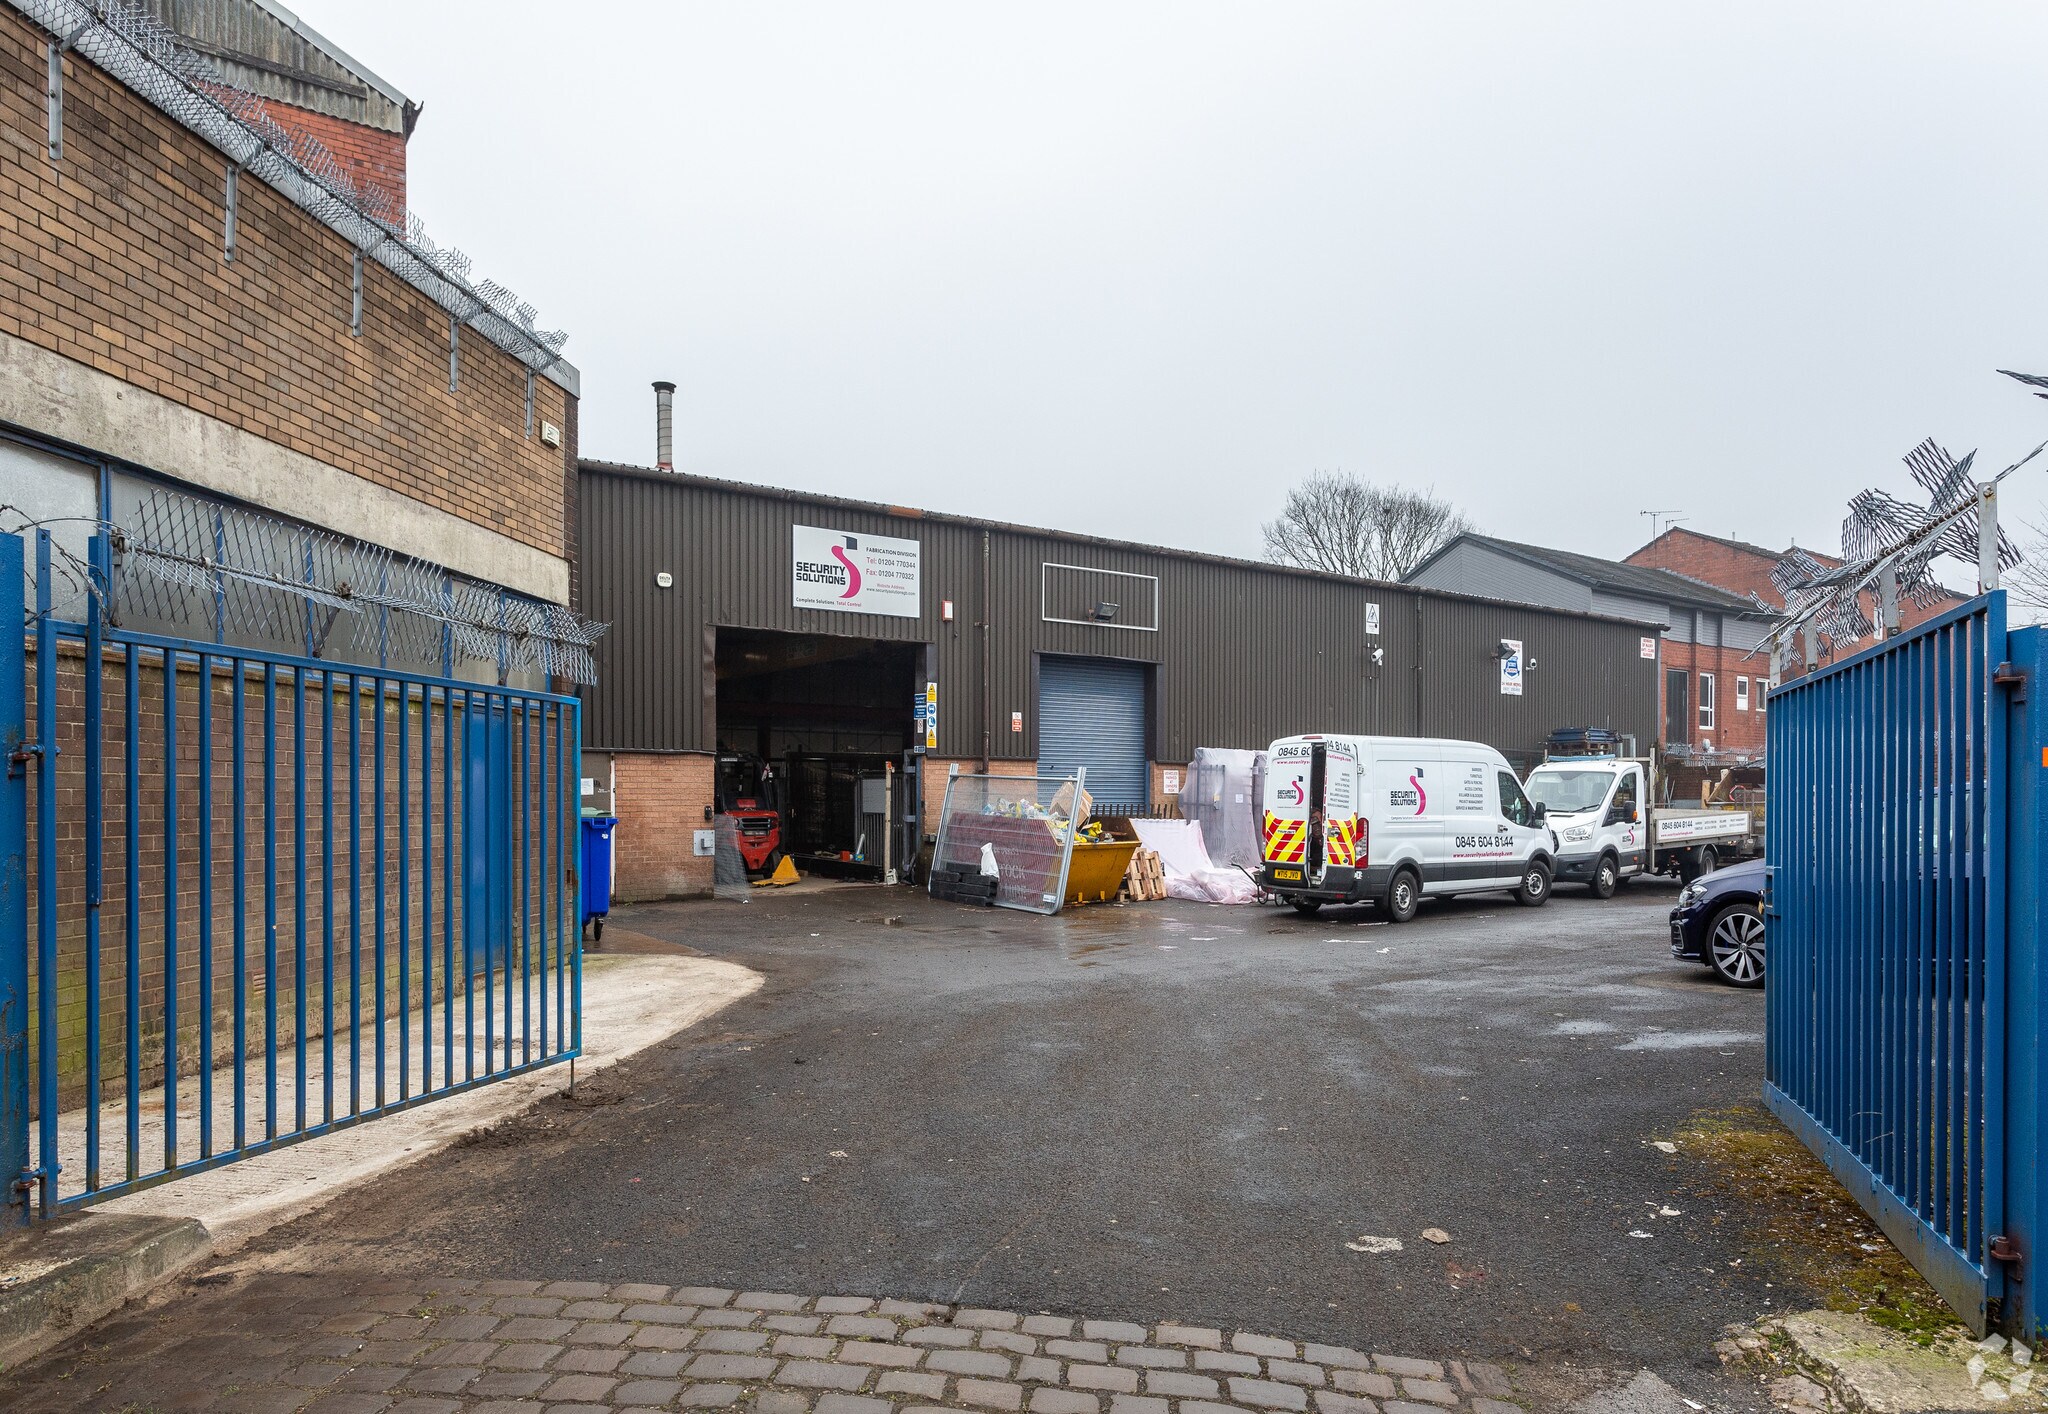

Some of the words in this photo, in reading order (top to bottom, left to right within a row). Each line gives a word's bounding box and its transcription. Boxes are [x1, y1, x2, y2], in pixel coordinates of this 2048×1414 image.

[866, 547, 896, 556] FABRICATION
[897, 550, 917, 558] DIVISION
[796, 561, 846, 576] SECURITY
[866, 557, 877, 565] Tel:
[878, 558, 895, 567] 01204
[896, 560, 916, 569] 770344
[796, 572, 846, 586] SOLUTIONS
[865, 568, 877, 577] Fax:
[878, 569, 894, 579] 01204
[895, 572, 915, 581] 770322
[1278, 747, 1299, 757] 0845
[1335, 741, 1351, 753] 8144
[1390, 791, 1417, 799] SECURITY
[1455, 836, 1476, 848] 0845
[1477, 836, 1493, 848] 604
[1494, 836, 1514, 847] 8144
